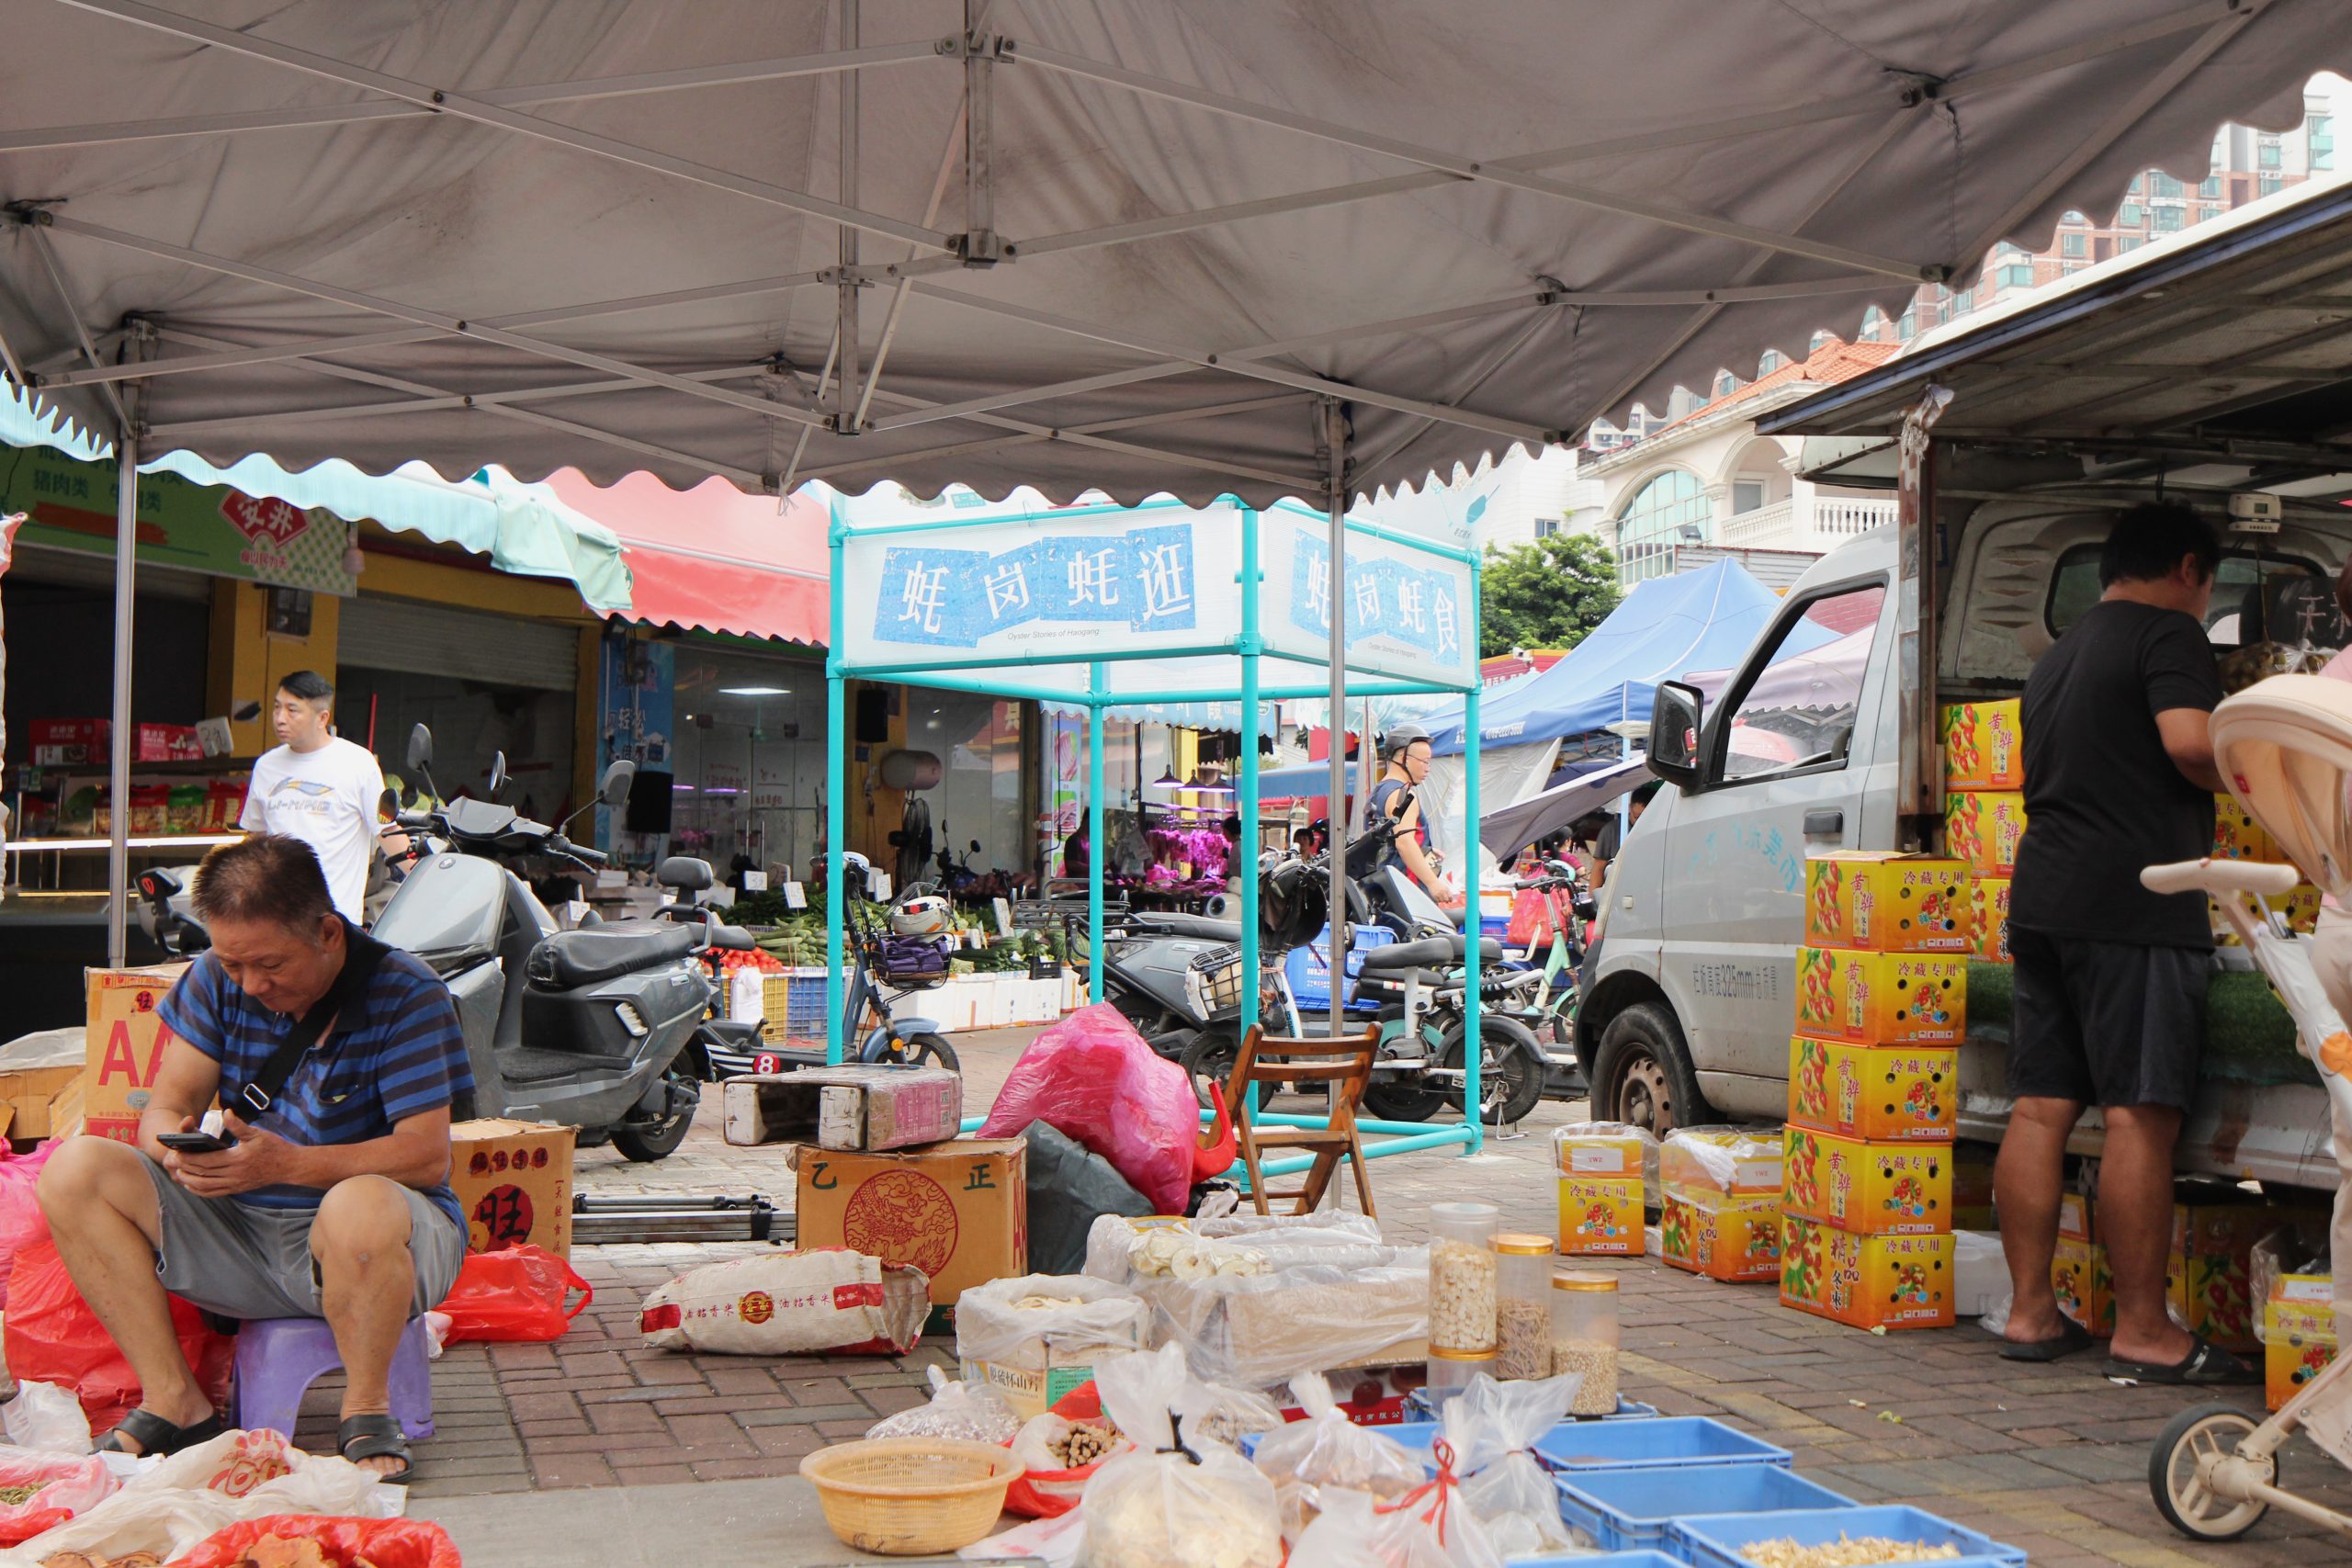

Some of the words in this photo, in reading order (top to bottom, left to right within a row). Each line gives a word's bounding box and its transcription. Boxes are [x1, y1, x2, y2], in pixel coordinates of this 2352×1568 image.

[237, 499, 294, 536] 安井
[898, 542, 1192, 634] 蚝岗蚝逛
[1007, 631, 1030, 641] Oyster
[1032, 629, 1057, 639] Stories
[1058, 629, 1067, 638] of
[1067, 627, 1100, 639] Haogang
[1987, 711, 2013, 750] 黄骅
[1992, 801, 2020, 840] 黄骅
[1904, 871, 1964, 886] 冷藏专用
[1850, 870, 1874, 913] 黄骅
[1844, 960, 1870, 1002] 黄骅
[1897, 963, 1959, 977] 冷藏专用
[136, 991, 153, 1009] 旺
[758, 1056, 773, 1072] 8
[1890, 1058, 1951, 1074] 冷藏专用
[1837, 1054, 1860, 1099] 黄骅
[1828, 1149, 1852, 1194] 黄骅
[1877, 1156, 1939, 1170] 冷藏专用
[812, 1162, 838, 1190] 乙
[963, 1163, 996, 1190] 正
[1569, 1184, 1627, 1197] 冷藏专用
[480, 1187, 528, 1244] 旺
[1886, 1238, 1940, 1253] 冷藏专用
[1830, 1233, 1860, 1282] 精品
[779, 1293, 831, 1309] 油粘香米
[1831, 1270, 1843, 1314] 冬枣
[684, 1303, 735, 1321] 油粘香米
[1353, 1411, 1400, 1423] 品有限公
